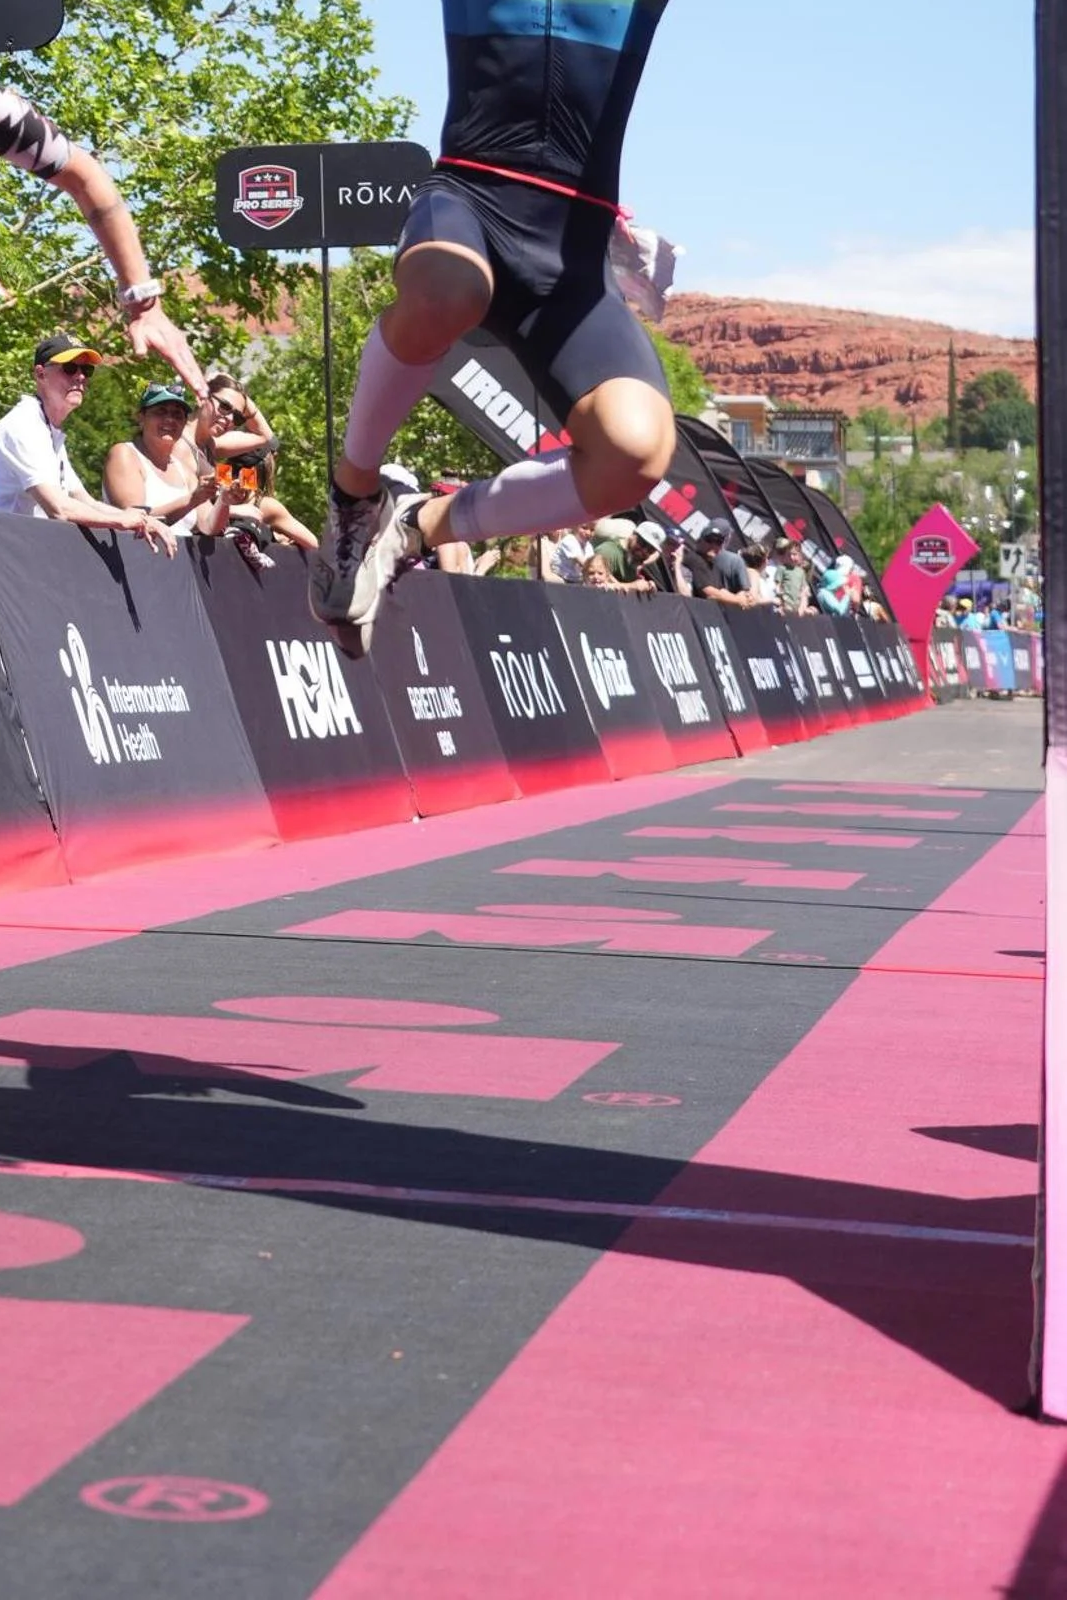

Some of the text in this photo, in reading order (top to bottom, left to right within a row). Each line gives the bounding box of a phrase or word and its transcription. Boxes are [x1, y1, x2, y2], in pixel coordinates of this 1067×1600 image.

[236, 198, 300, 210] PRO SERIES
[646, 631, 699, 699] QATAR
[102, 675, 191, 714] Intermountain
[266, 639, 364, 740] HOKA
[407, 685, 463, 721] BREITLING
[117, 724, 163, 762] Health
